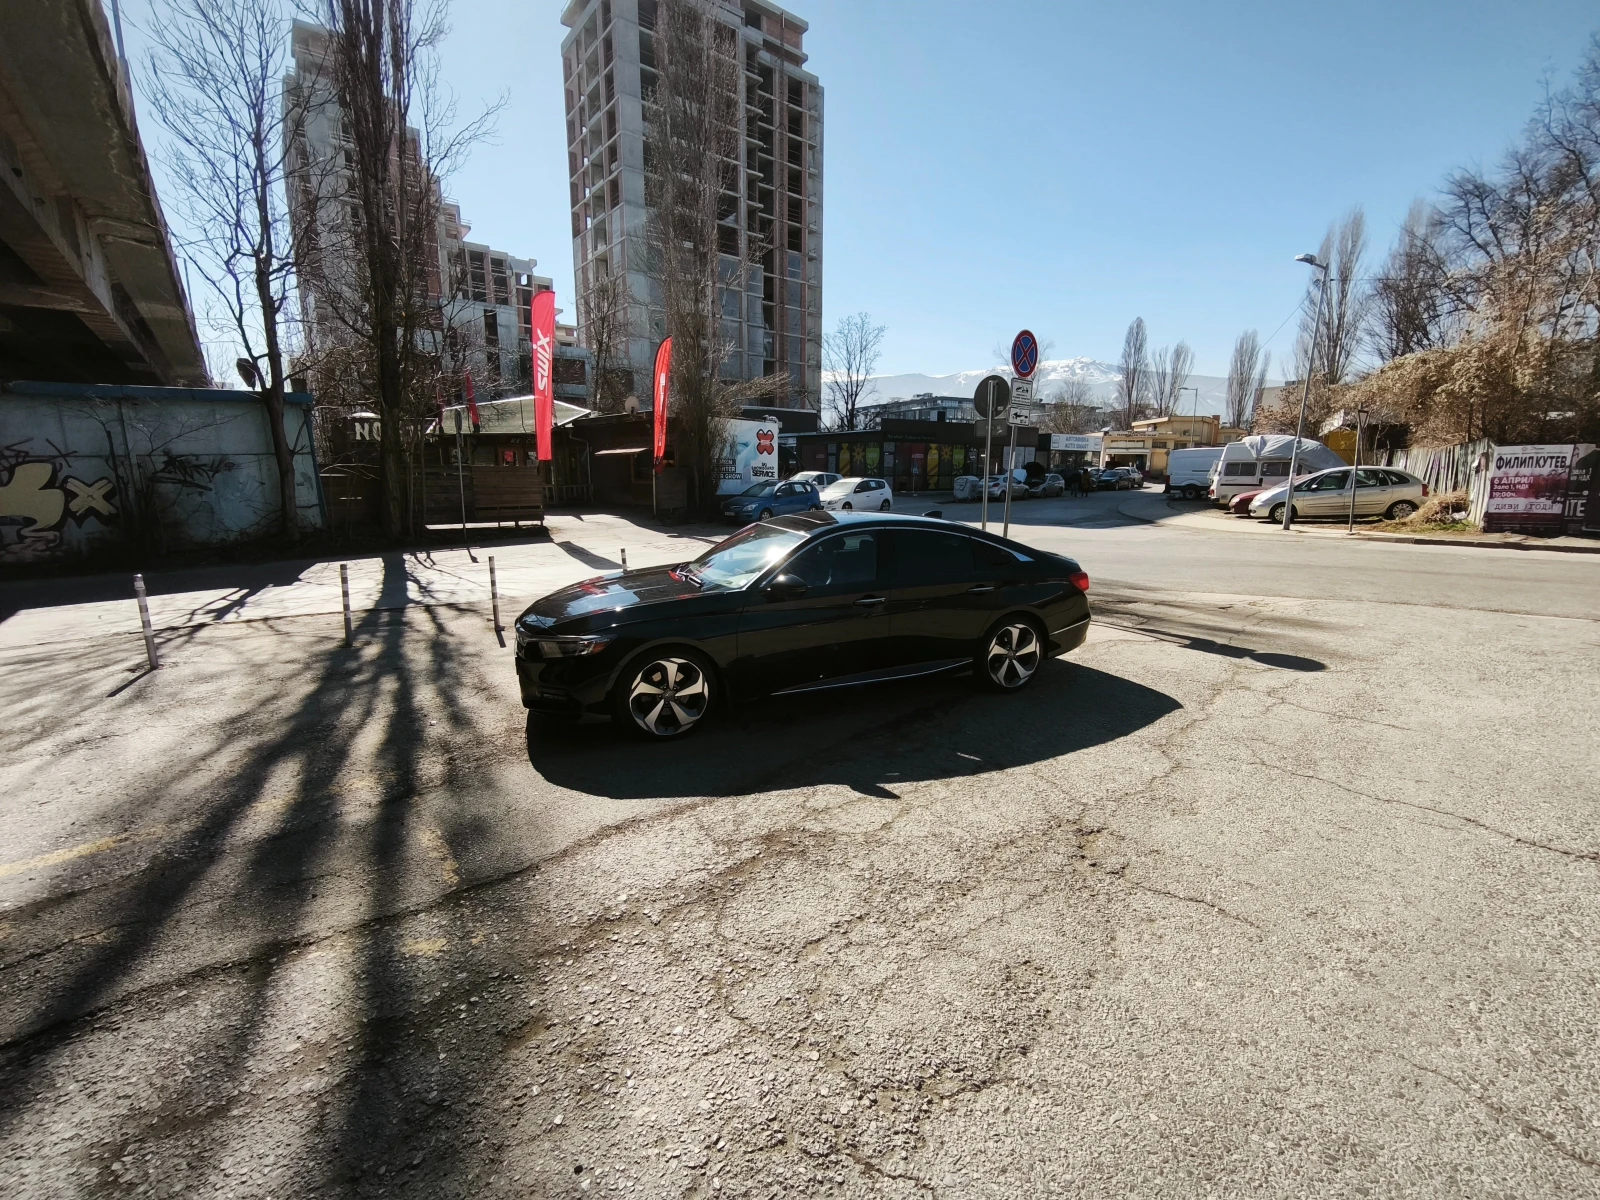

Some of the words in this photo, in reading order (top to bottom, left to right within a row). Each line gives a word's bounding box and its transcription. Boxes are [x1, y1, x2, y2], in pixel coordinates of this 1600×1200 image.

[1496, 456, 1534, 470] ФИЛИП
[1535, 456, 1567, 469] КУТЕВ
[752, 470, 775, 478] SERVICE
